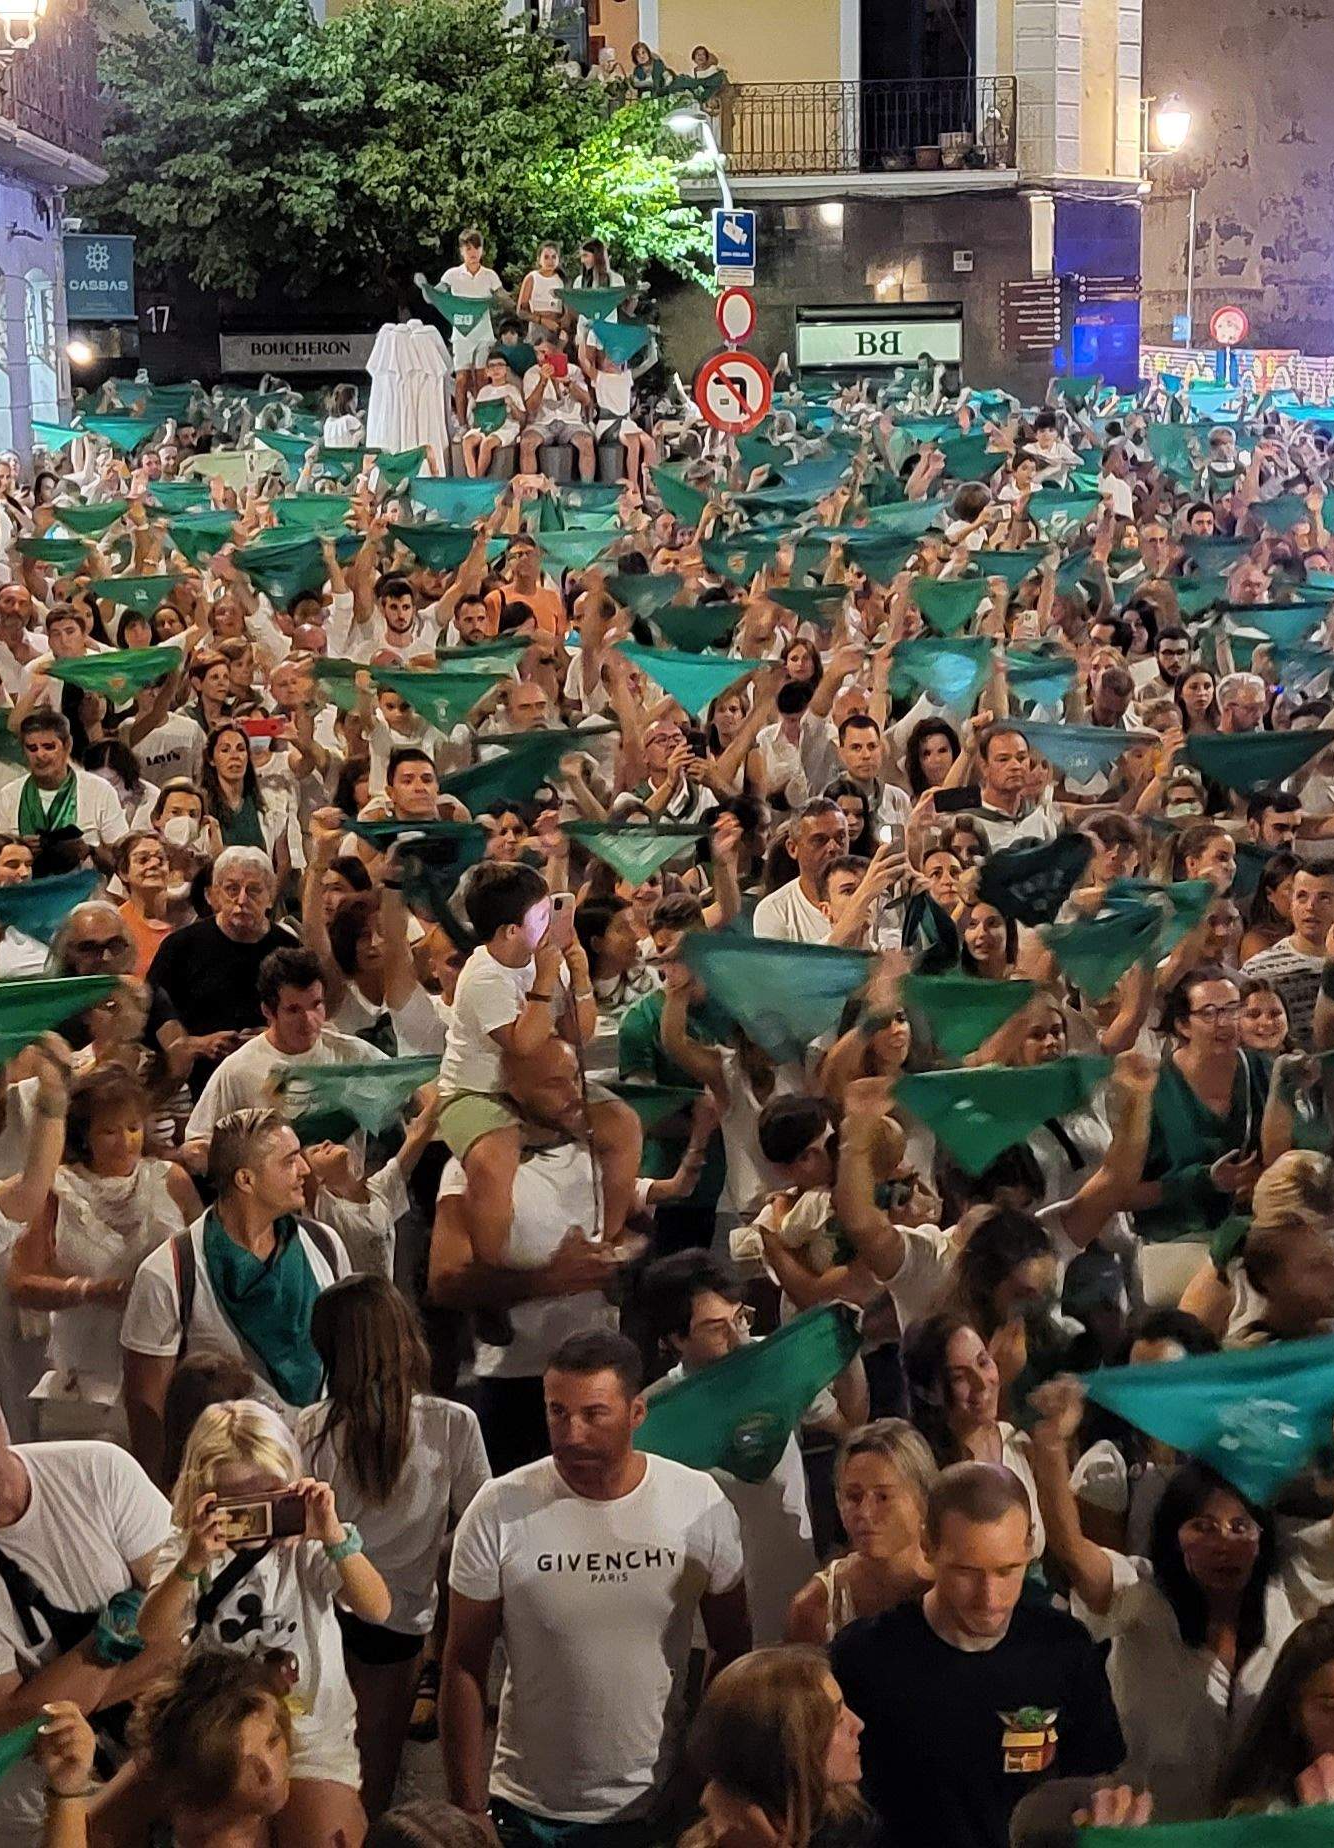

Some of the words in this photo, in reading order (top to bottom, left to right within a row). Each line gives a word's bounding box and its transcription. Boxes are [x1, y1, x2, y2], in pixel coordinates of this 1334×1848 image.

[69, 280, 129, 291] CASBAS
[146, 306, 170, 334] 17
[250, 341, 351, 356] BOUCHERON
[537, 1548, 677, 1573] GIVENCHY
[590, 1572, 629, 1584] PARIS
